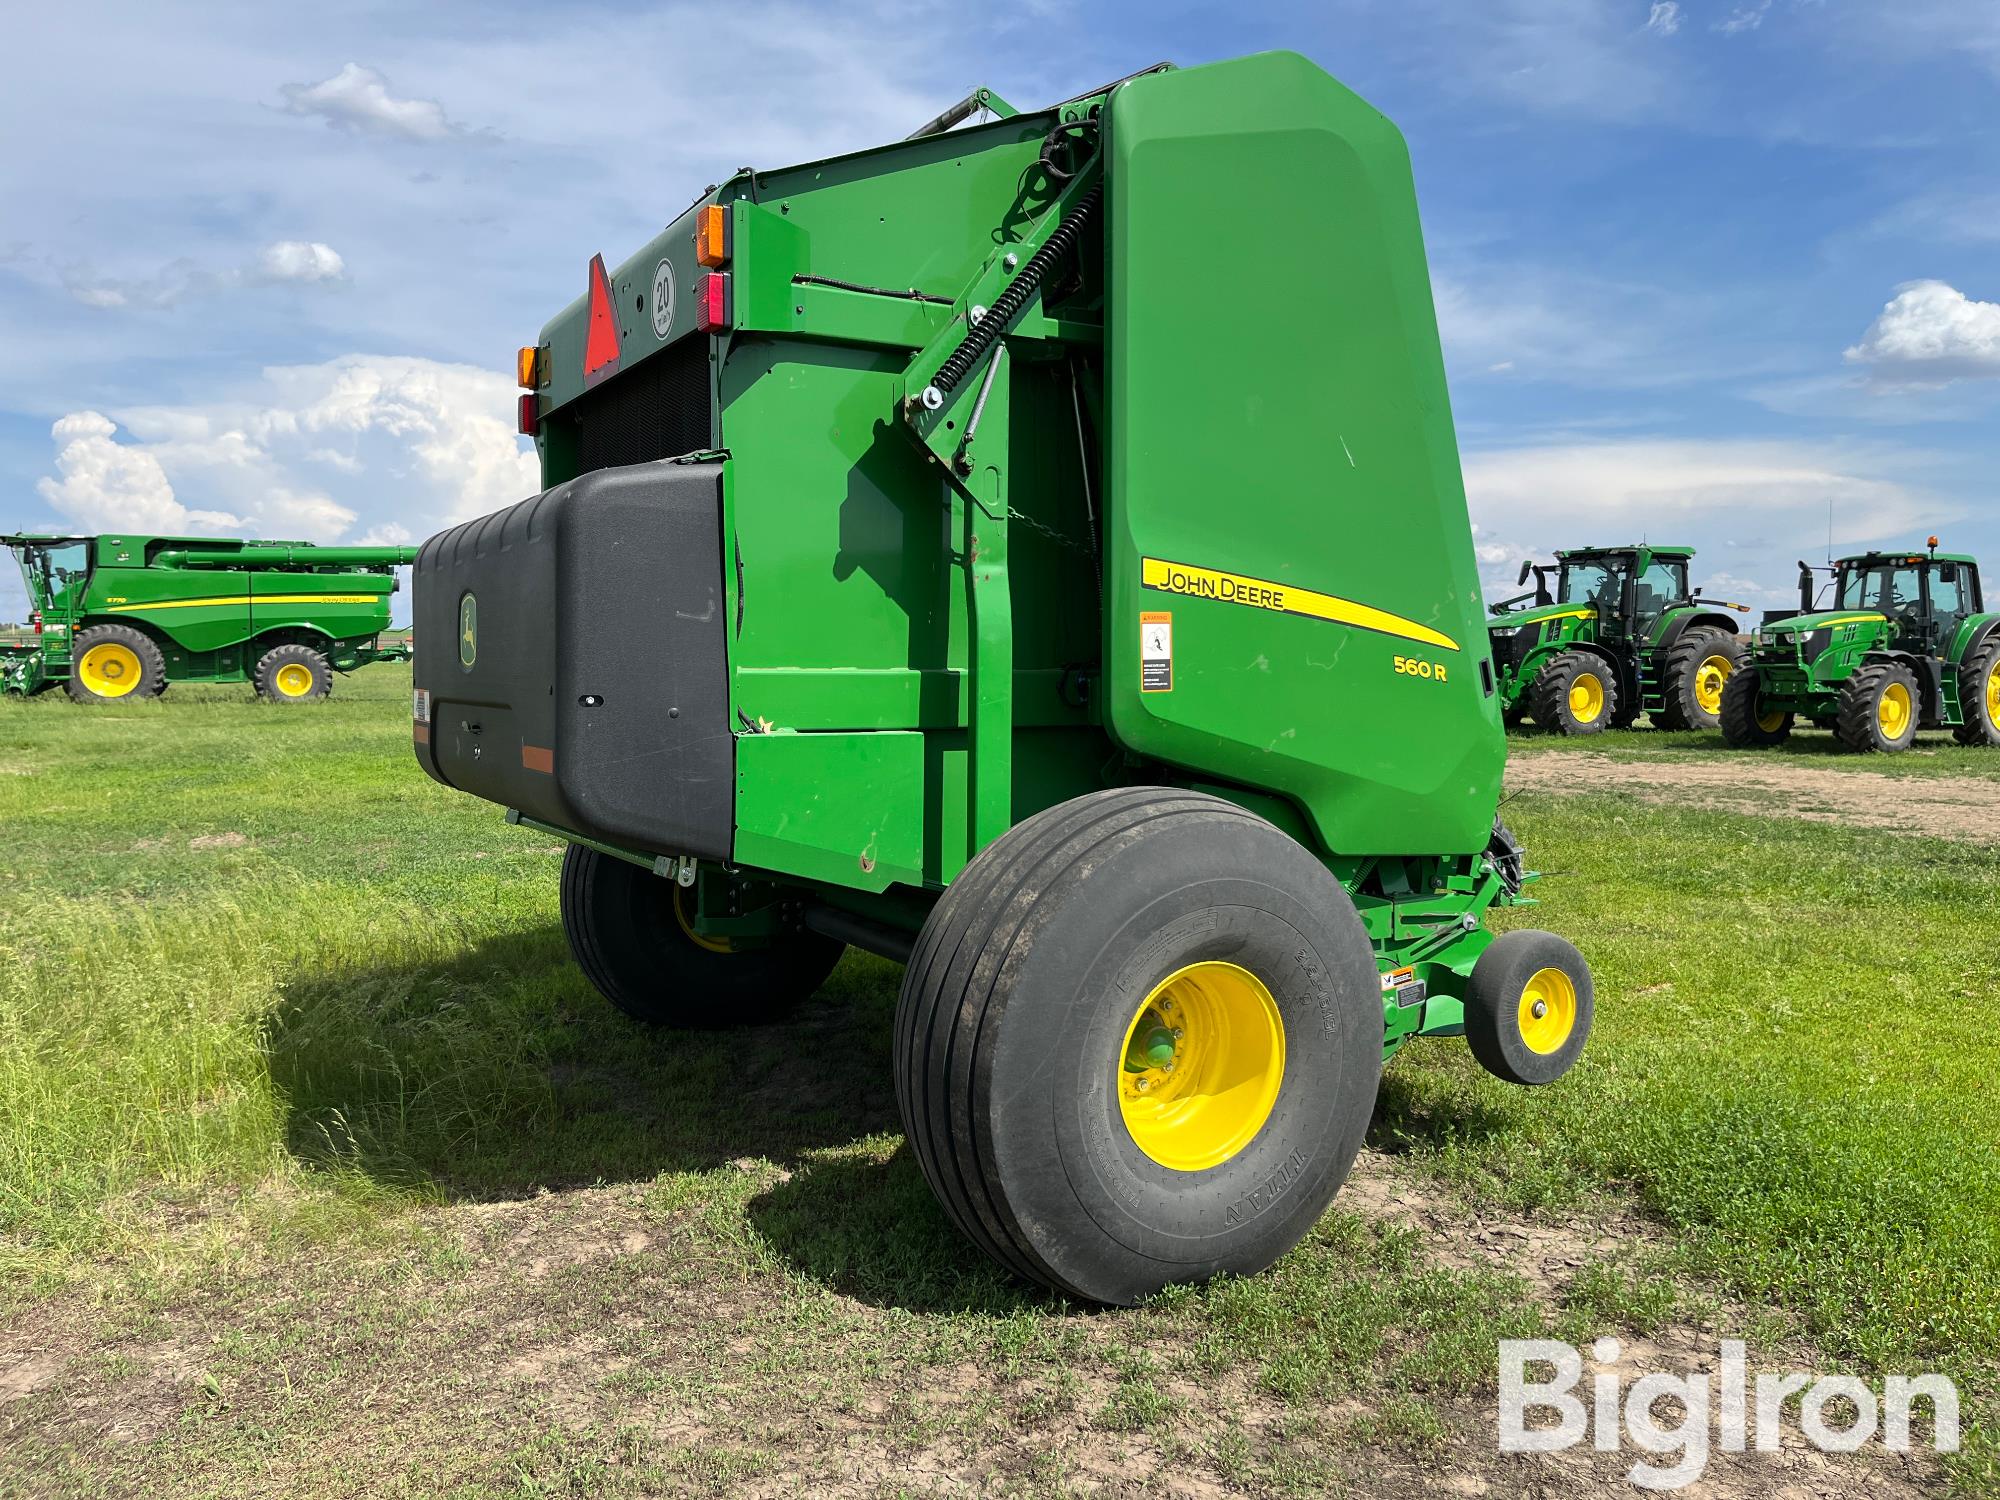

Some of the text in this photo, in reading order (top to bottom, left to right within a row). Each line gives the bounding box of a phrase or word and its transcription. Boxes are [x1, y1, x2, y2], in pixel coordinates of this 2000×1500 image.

[657, 276, 670, 314] 20
[1160, 568, 1284, 608] JOHN DEERE
[1393, 655, 1447, 683] 560 R
[1224, 1146, 1306, 1228] TITAN
